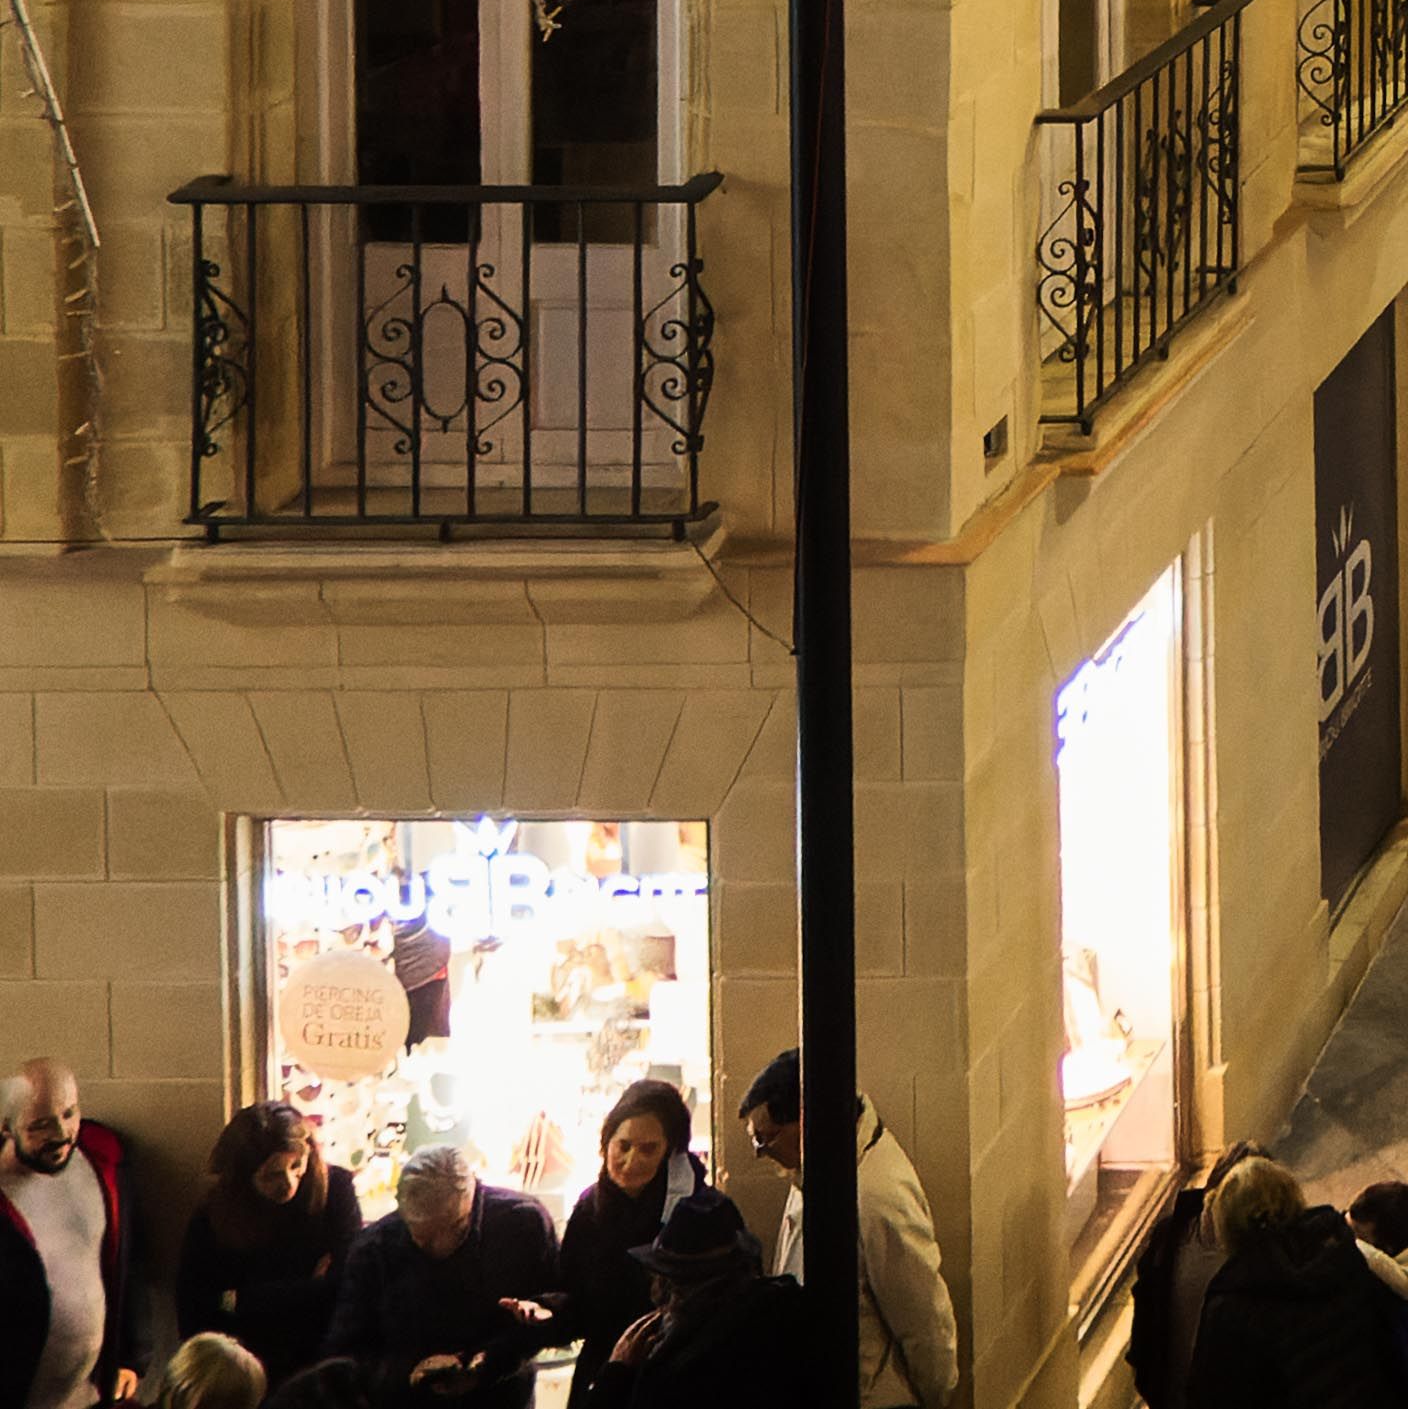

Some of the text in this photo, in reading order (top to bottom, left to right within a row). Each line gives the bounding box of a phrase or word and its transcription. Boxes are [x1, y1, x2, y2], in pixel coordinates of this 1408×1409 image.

[303, 984, 384, 1005] PIERCING
[303, 1003, 383, 1022] DE OREJA
